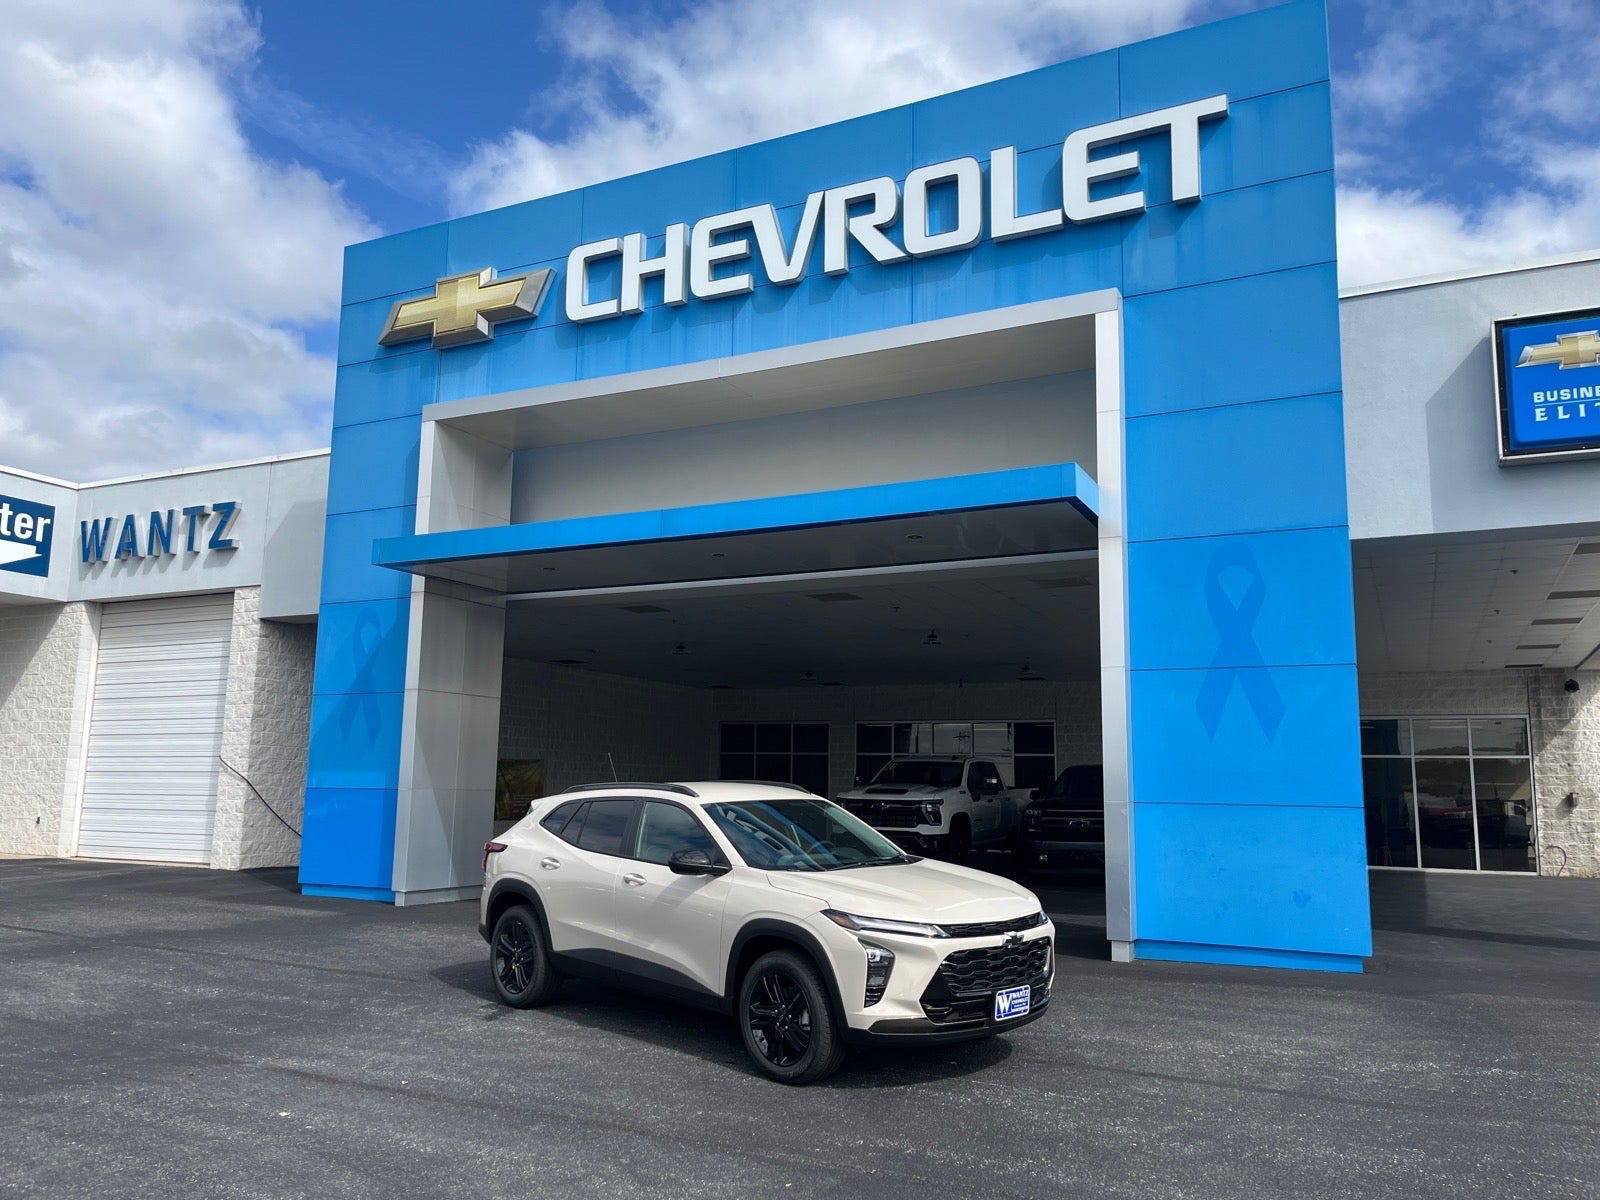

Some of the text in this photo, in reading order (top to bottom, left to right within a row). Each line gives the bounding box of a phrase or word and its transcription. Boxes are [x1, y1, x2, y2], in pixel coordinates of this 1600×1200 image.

[565, 93, 1229, 324] CHEVROLET
[0, 502, 51, 542] ter
[80, 501, 242, 563] WANTZ
